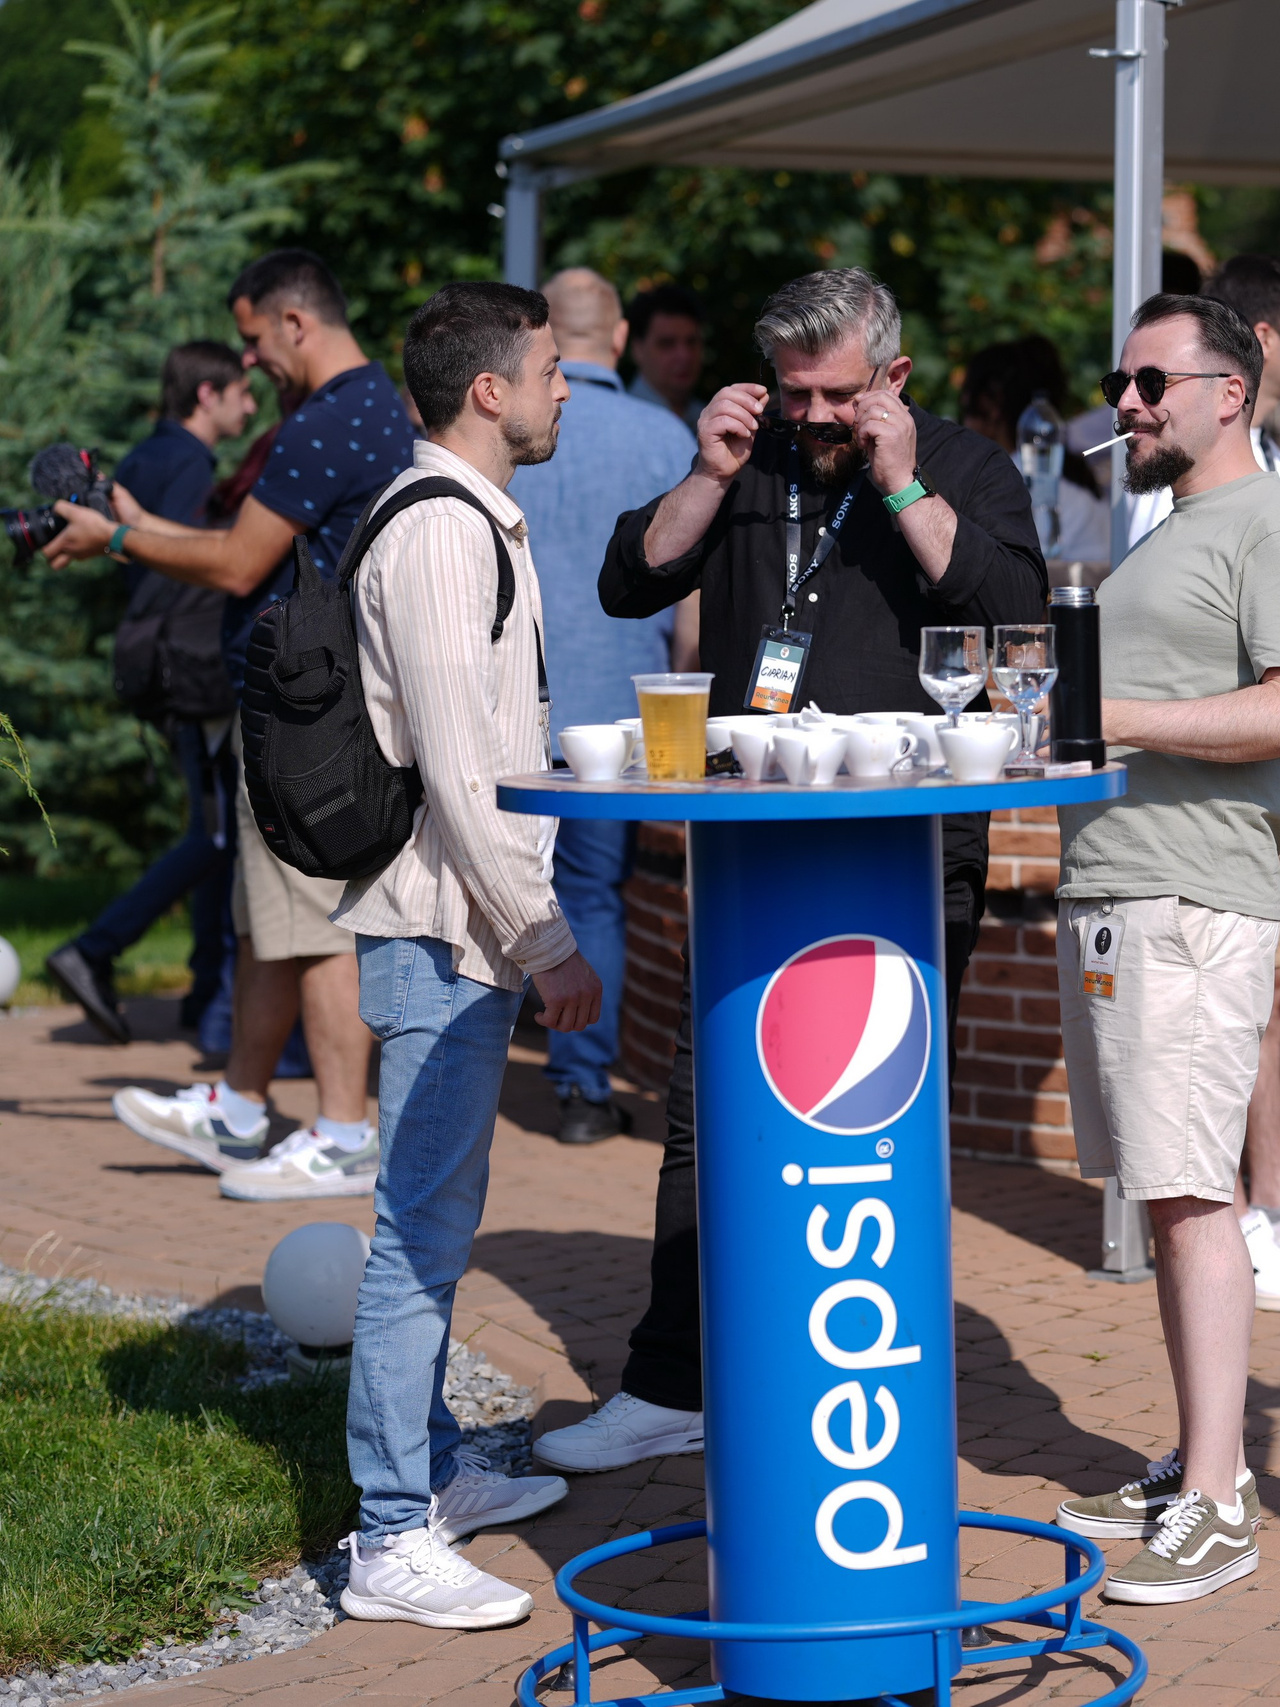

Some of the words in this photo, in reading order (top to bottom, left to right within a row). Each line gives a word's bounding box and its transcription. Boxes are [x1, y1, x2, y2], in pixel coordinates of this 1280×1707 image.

[789, 484, 798, 520] SONY
[832, 492, 853, 529] SONY
[789, 553, 798, 587] SON
[792, 558, 819, 593] SONY
[761, 666, 796, 683] CIPRIAN
[782, 1163, 927, 1571] pepsi
